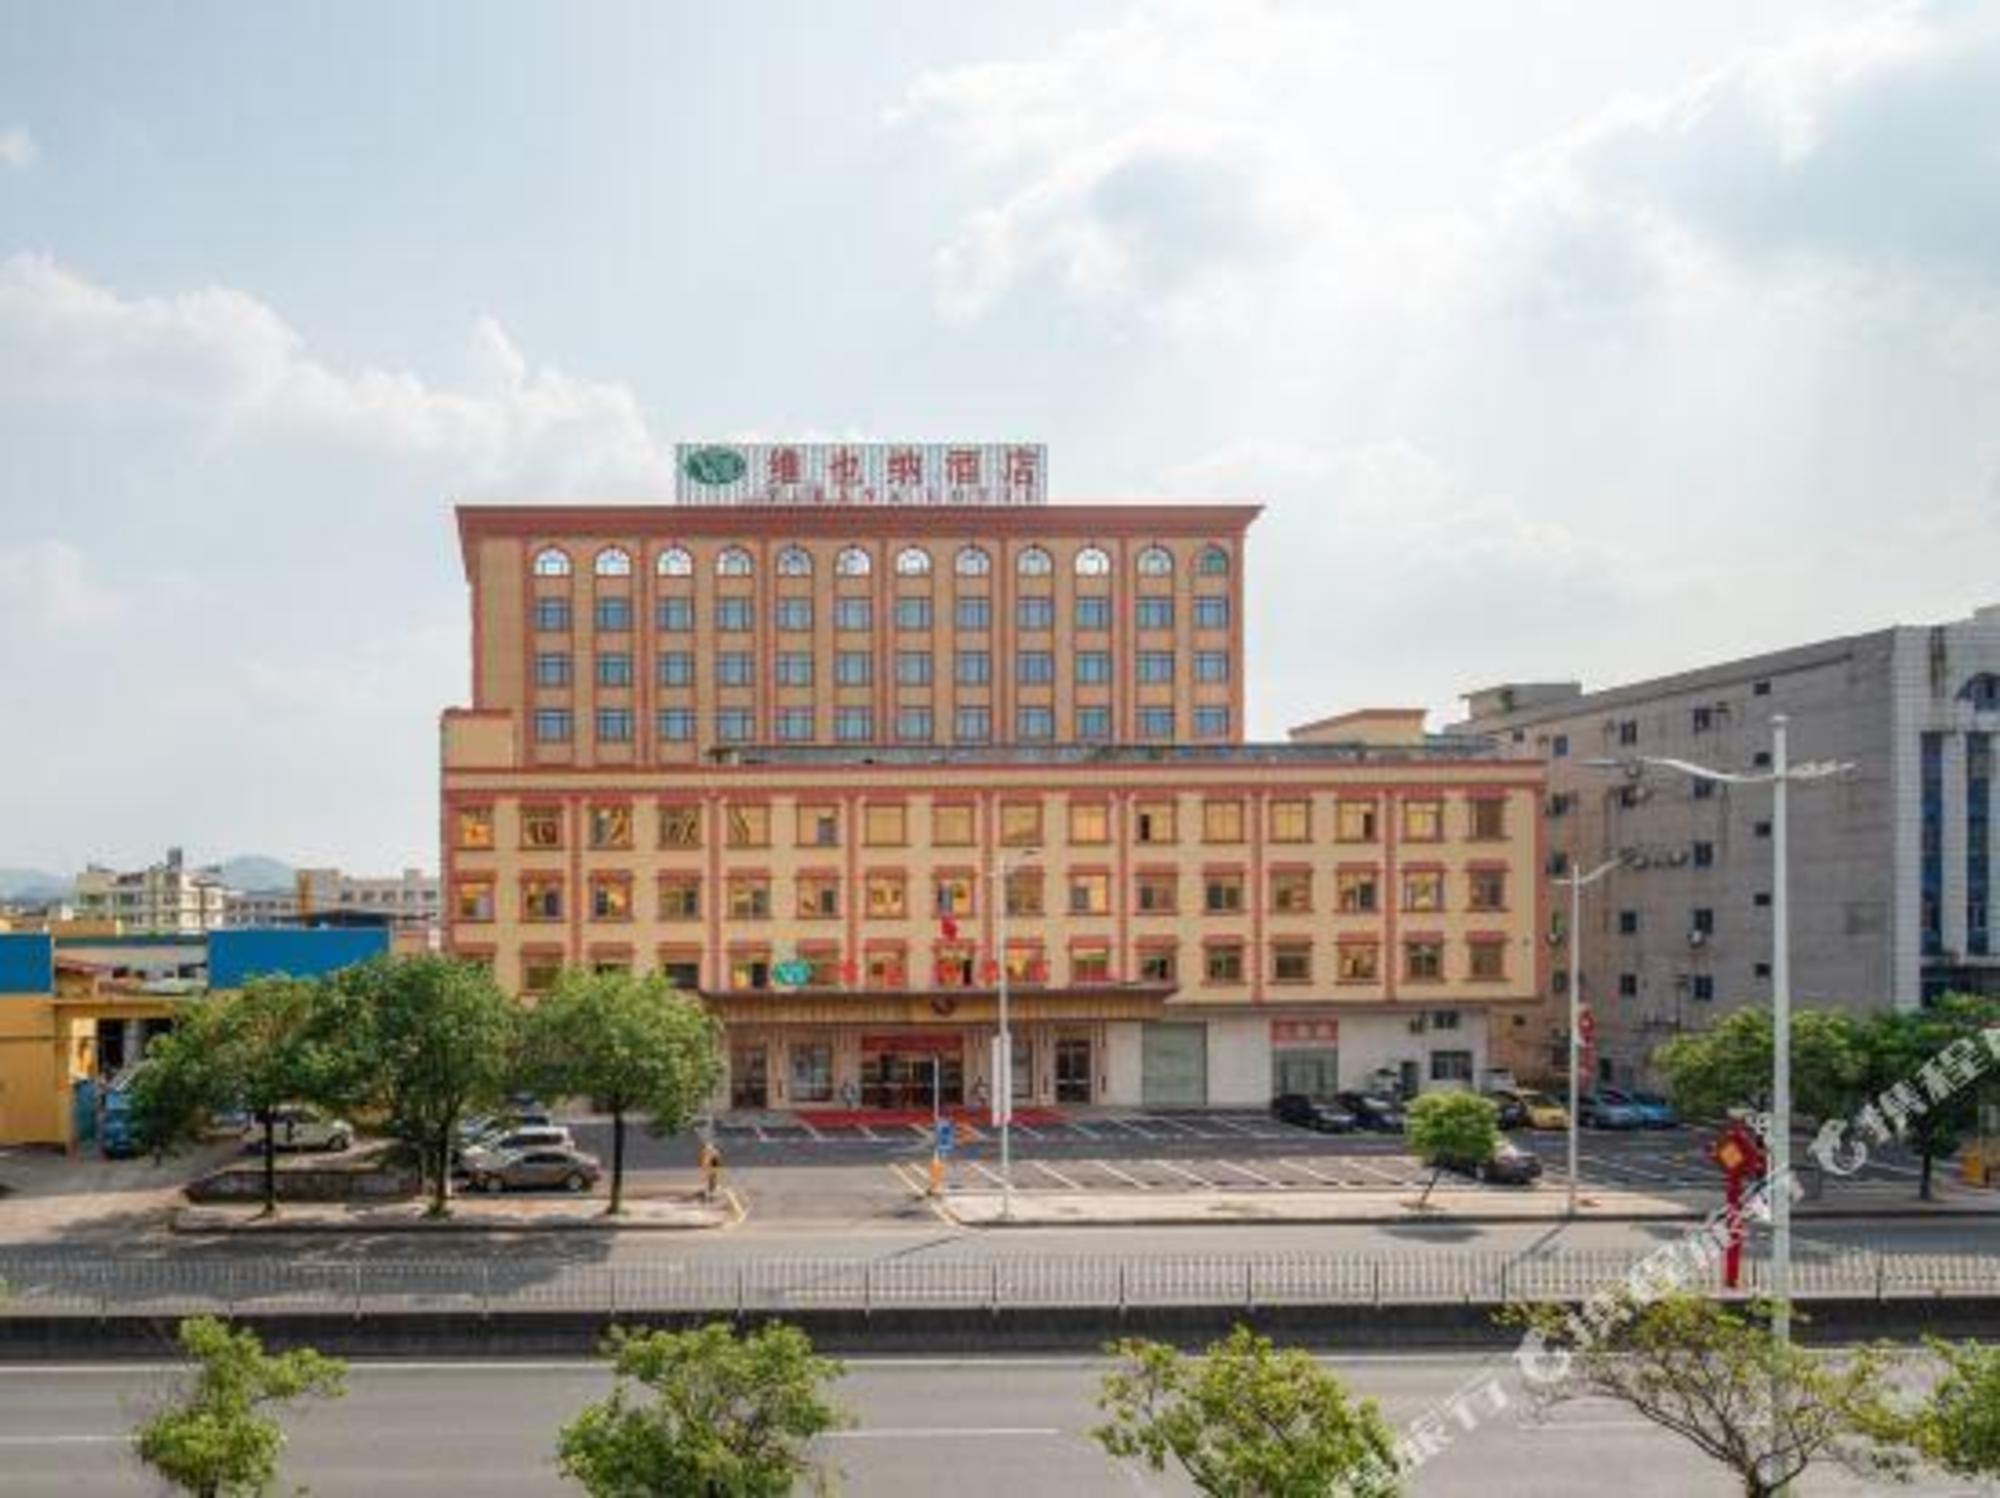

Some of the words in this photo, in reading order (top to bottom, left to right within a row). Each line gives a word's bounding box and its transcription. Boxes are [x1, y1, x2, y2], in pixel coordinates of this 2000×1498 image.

[768, 448, 1037, 485] 维也纳酒店
